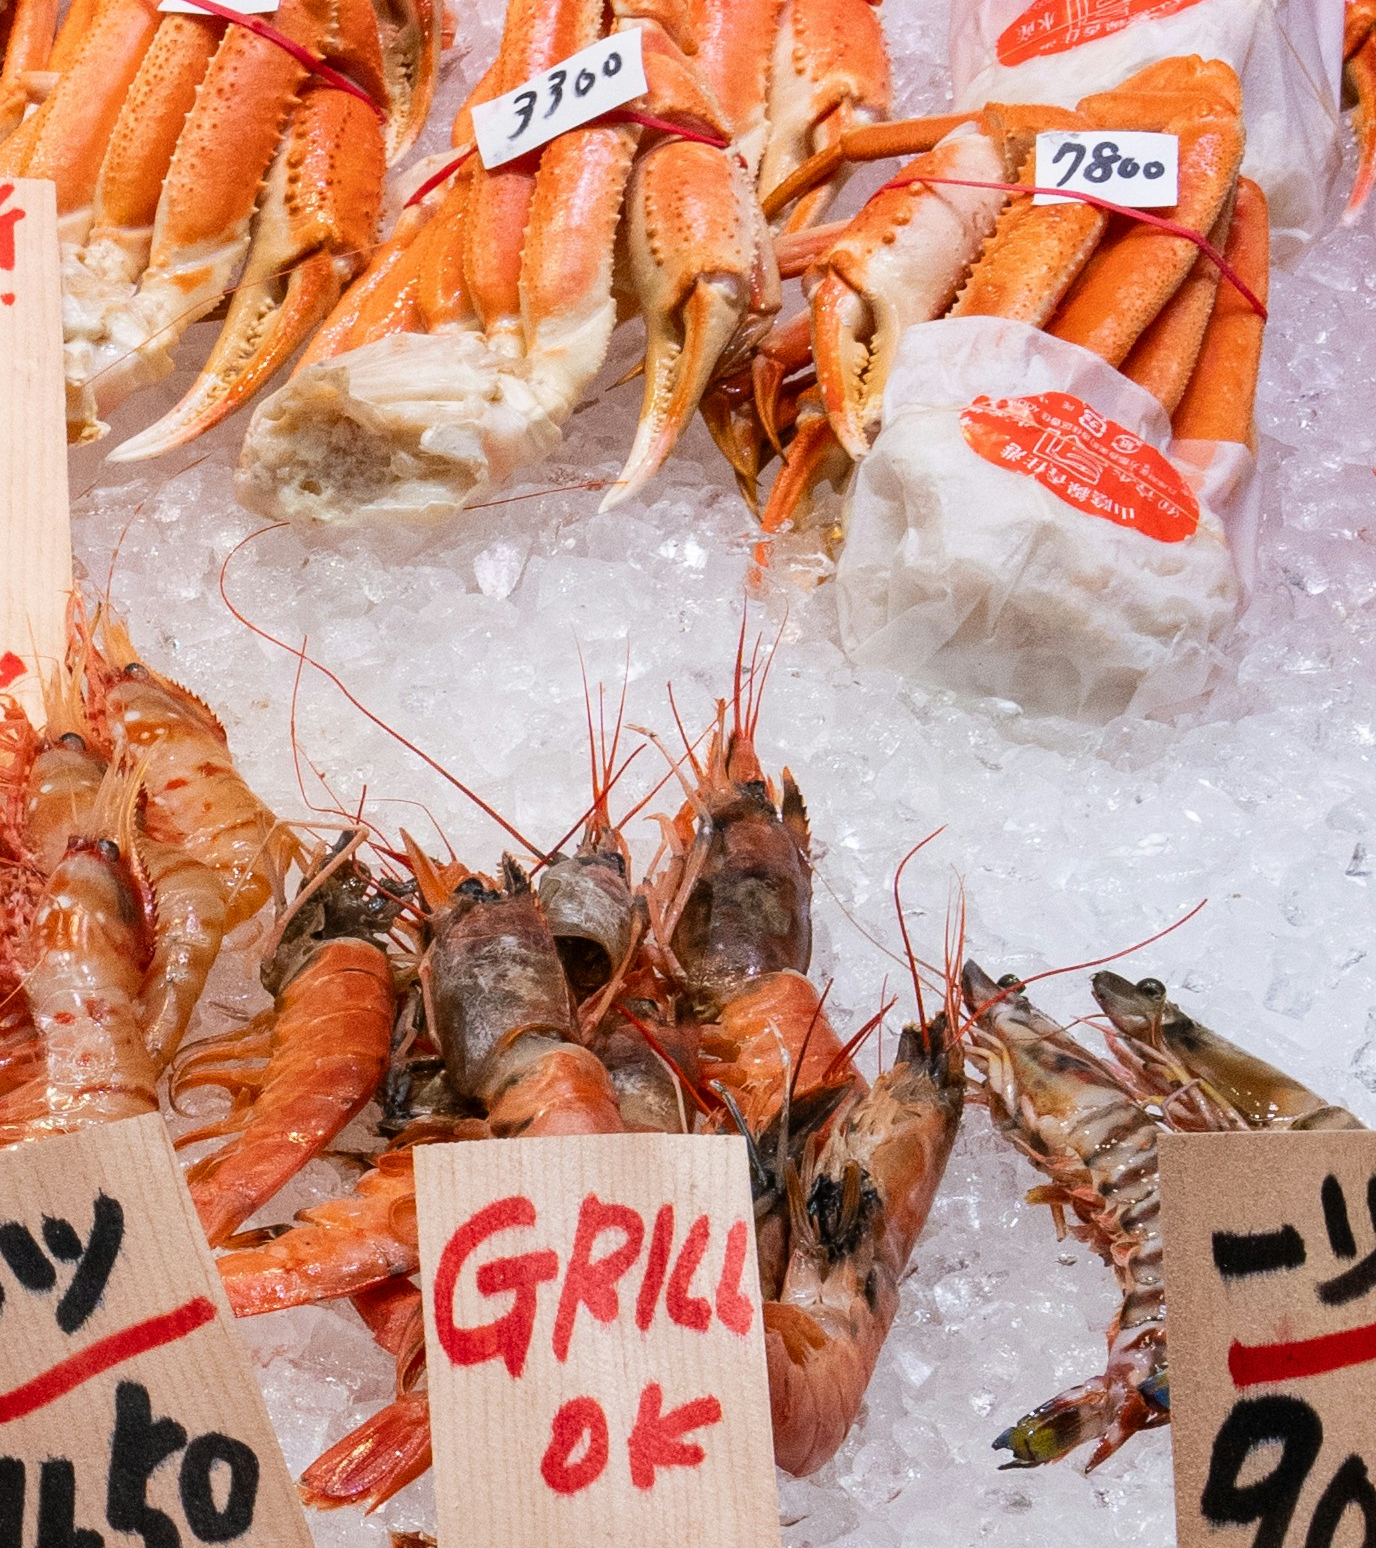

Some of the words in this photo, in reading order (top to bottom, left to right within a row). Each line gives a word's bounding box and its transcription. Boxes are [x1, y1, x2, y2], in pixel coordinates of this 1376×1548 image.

[507, 49, 625, 144] 3300
[1051, 140, 1166, 188] 7800
[434, 1193, 753, 1378] GRILL
[540, 1382, 722, 1497] OK
